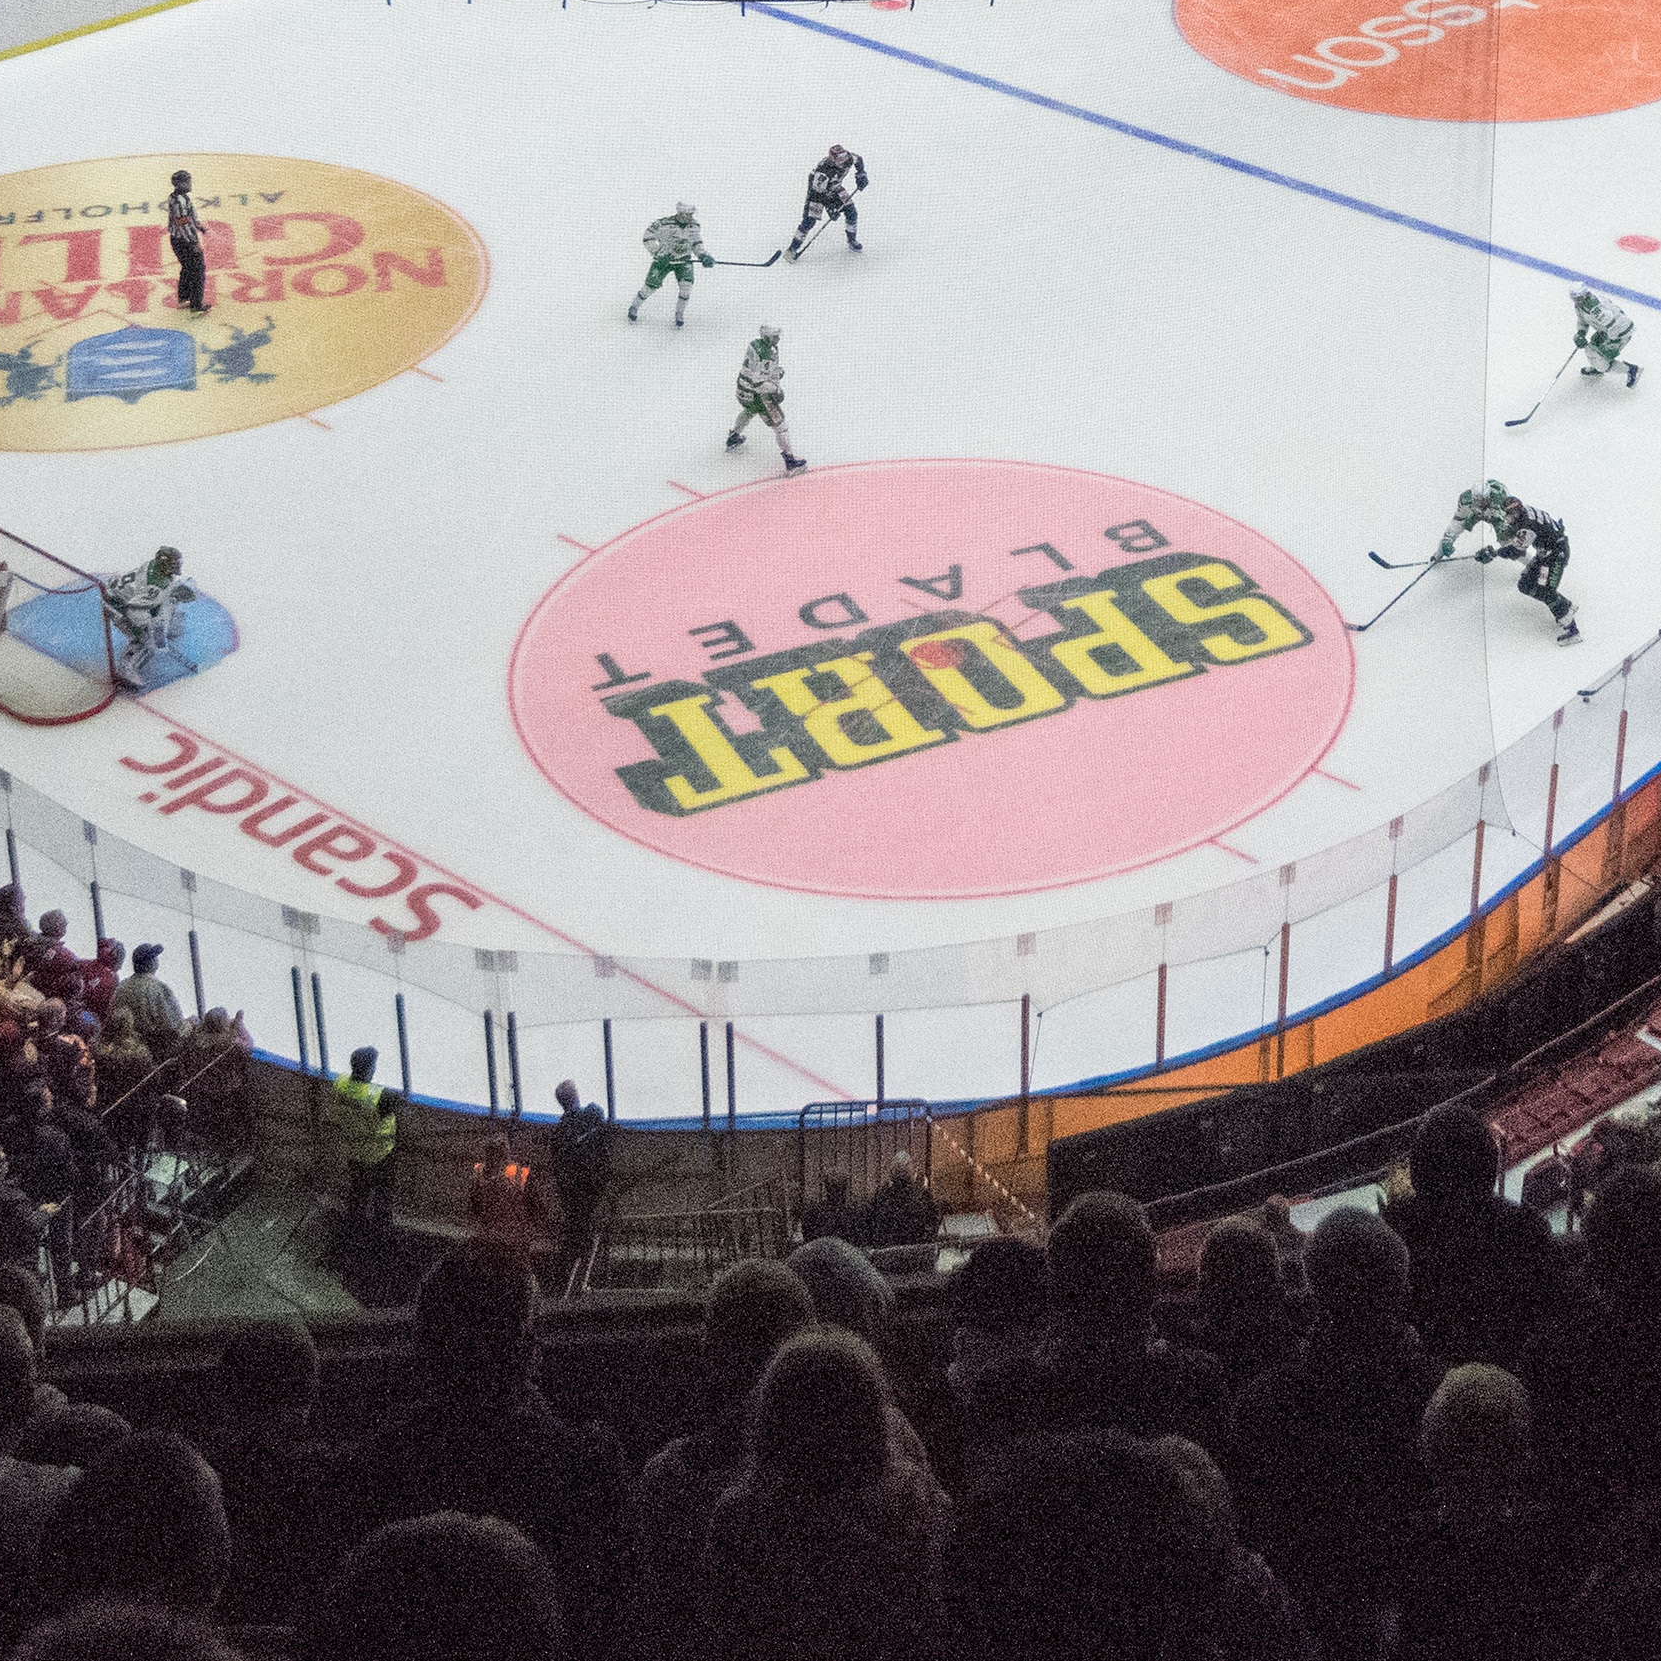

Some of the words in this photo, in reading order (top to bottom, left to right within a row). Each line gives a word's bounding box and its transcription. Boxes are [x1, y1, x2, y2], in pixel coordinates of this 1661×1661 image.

[591, 518, 1171, 693] BLADET
[615, 552, 1314, 817] SPORT
[118, 732, 484, 942] Scandic
